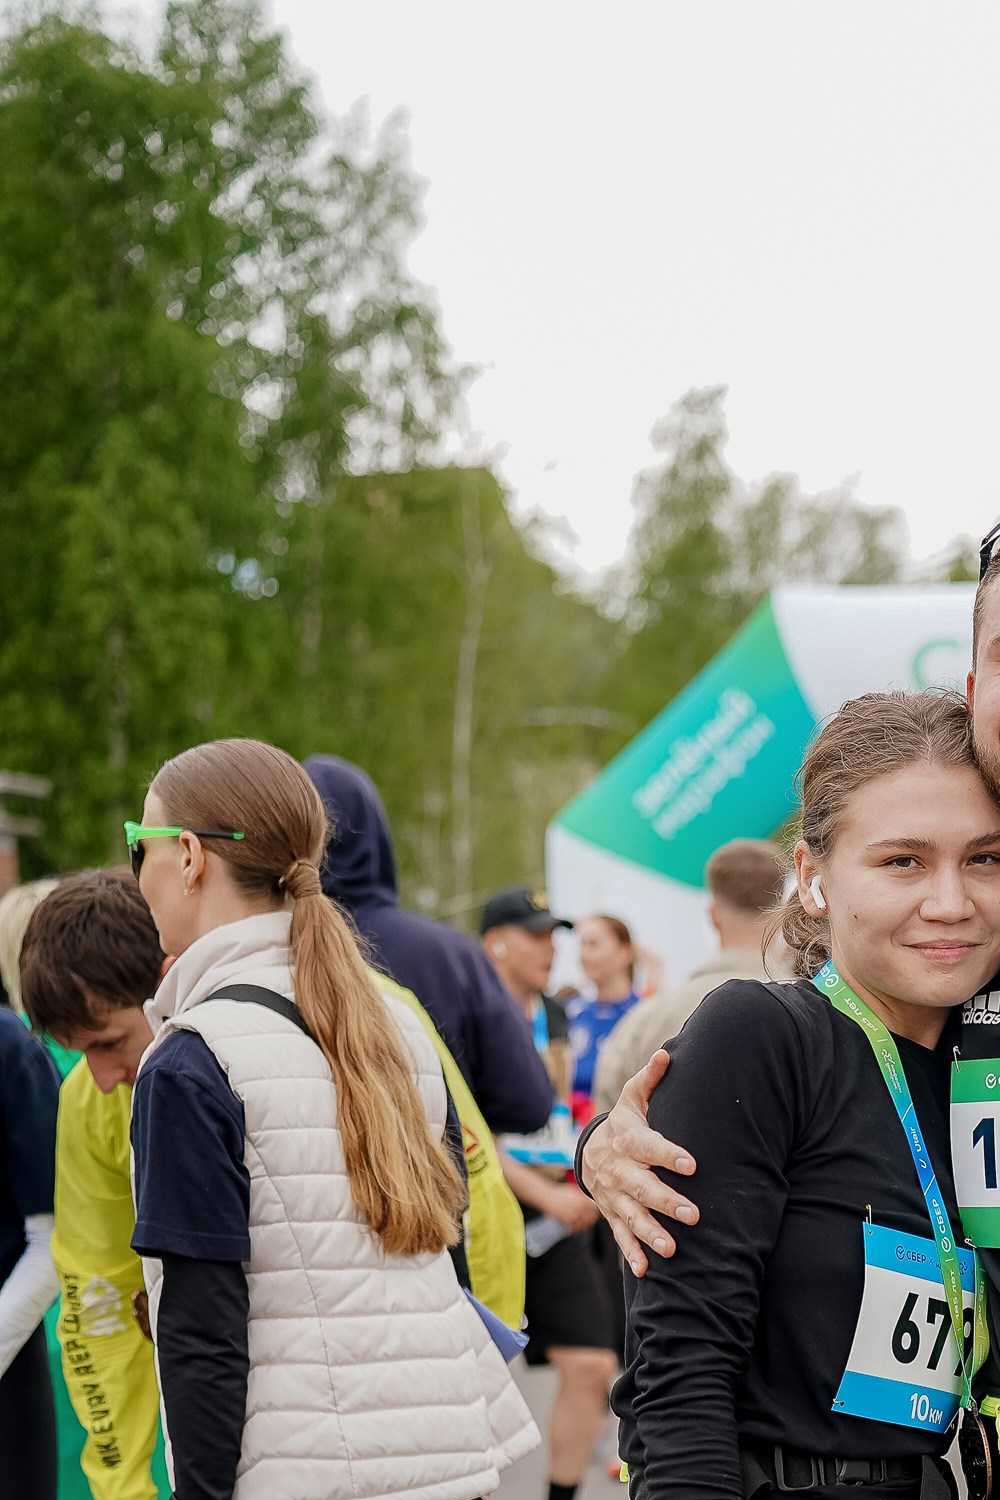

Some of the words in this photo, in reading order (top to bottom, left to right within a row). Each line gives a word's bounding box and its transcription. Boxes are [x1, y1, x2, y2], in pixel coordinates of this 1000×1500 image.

[931, 1198, 946, 1234] СБЕР
[906, 1252, 927, 1263] СБЕР
[65, 1338, 97, 1377] REP
